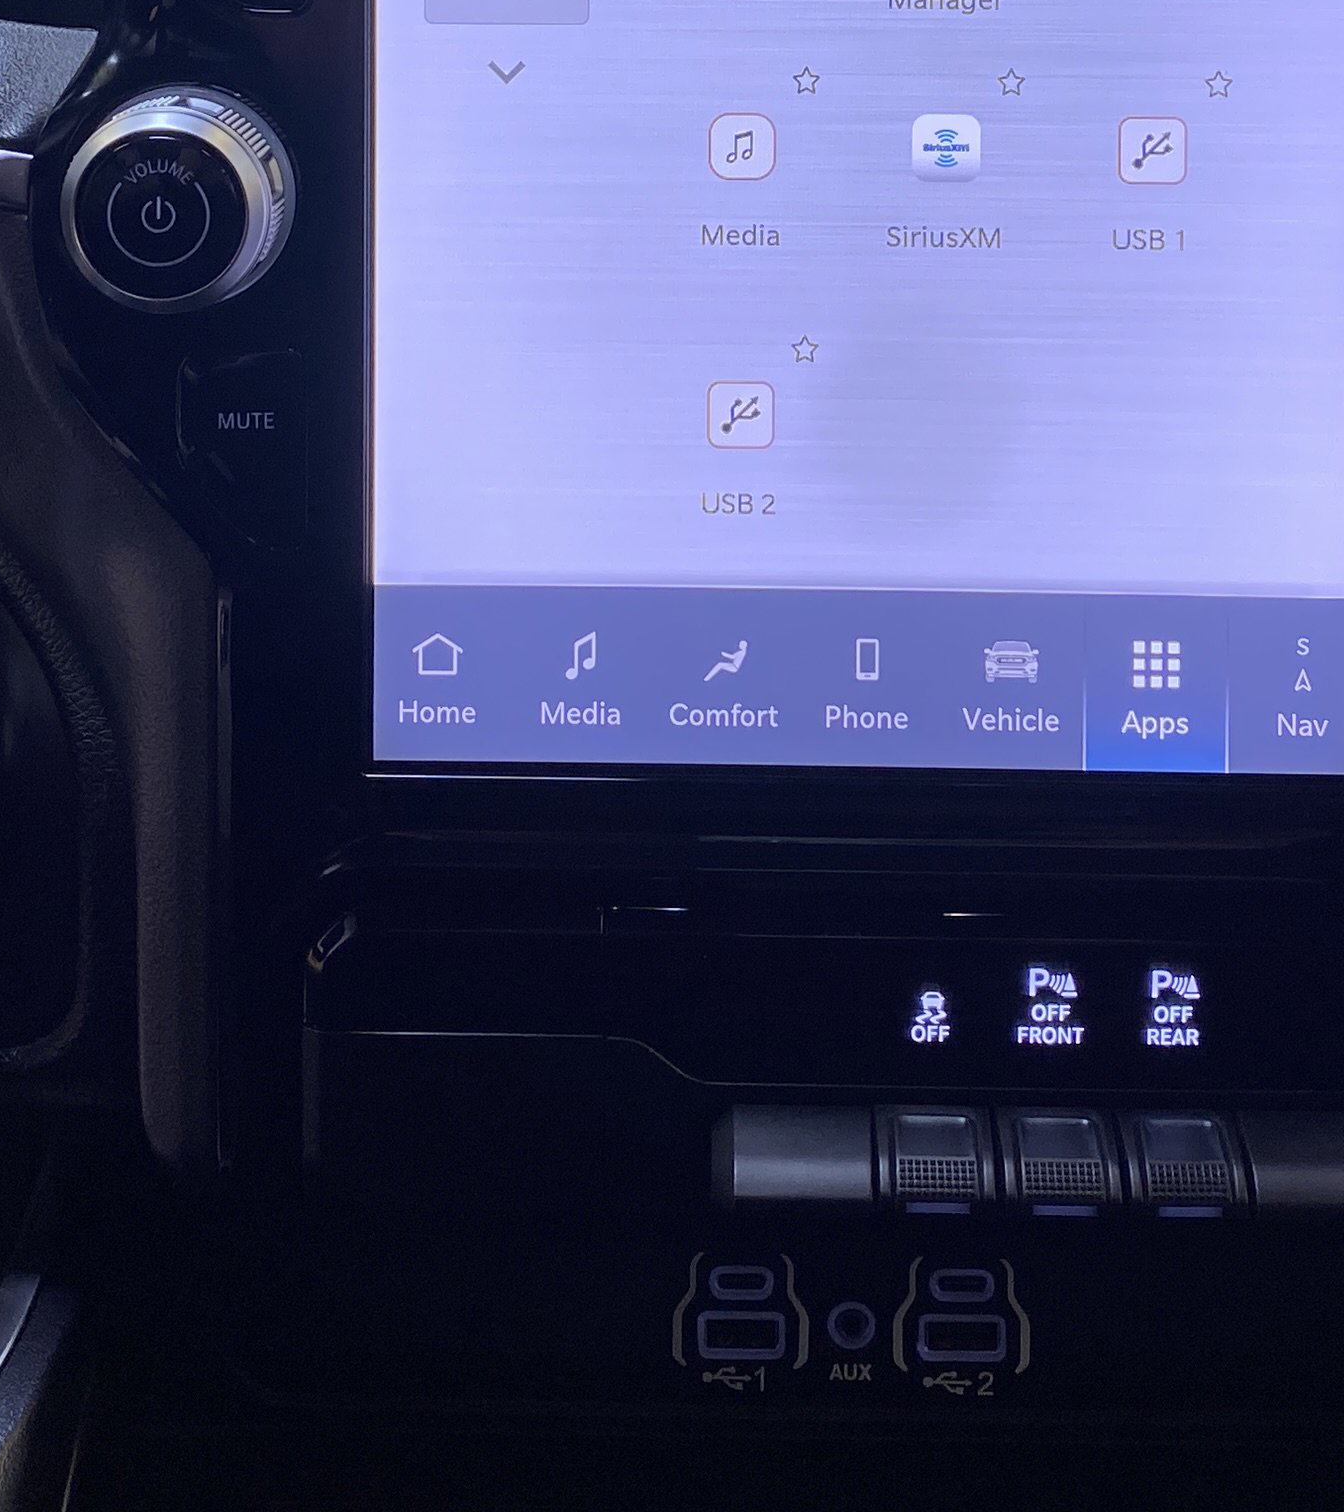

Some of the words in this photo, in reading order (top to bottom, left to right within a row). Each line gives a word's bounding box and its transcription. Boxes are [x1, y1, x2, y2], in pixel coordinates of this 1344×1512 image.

[124, 158, 194, 185] VOLUME
[702, 223, 780, 247] Media
[886, 225, 1001, 249] SiriusXM
[1112, 229, 1165, 251] USB
[1175, 229, 1185, 252] 1
[218, 411, 275, 430] MUTE
[702, 492, 754, 515] USB
[761, 493, 777, 515] 2
[1296, 637, 1310, 656] S
[398, 699, 476, 724] Home
[540, 700, 621, 726] Media
[669, 702, 779, 728] Comfort
[825, 704, 909, 730] Phone
[962, 706, 1060, 732] Vehicle
[1121, 710, 1189, 740] Apps
[1277, 713, 1329, 737] Nav
[1030, 1003, 1072, 1022] OFF
[1153, 1005, 1194, 1024] OFF
[910, 1020, 951, 1043] OFF
[1017, 1025, 1085, 1046] FRONT
[1146, 1027, 1200, 1047] REAR
[754, 1366, 765, 1392] 1
[829, 1363, 872, 1382] AUX
[977, 1371, 994, 1396] 2
